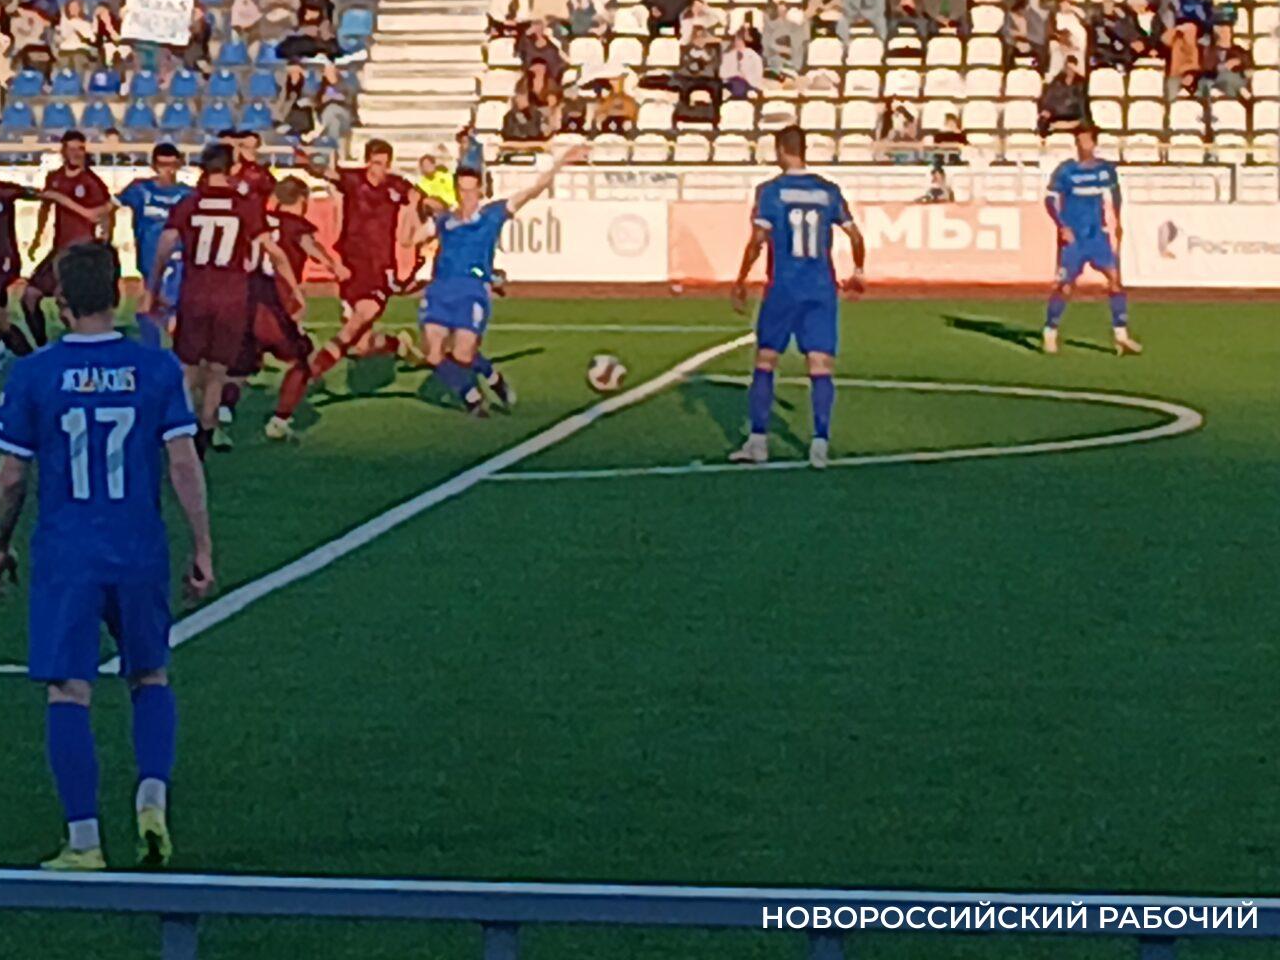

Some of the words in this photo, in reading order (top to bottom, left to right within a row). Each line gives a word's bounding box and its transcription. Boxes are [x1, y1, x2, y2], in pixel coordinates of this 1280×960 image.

[190, 214, 240, 266] 77
[788, 208, 819, 258] 11
[61, 407, 136, 500] 17
